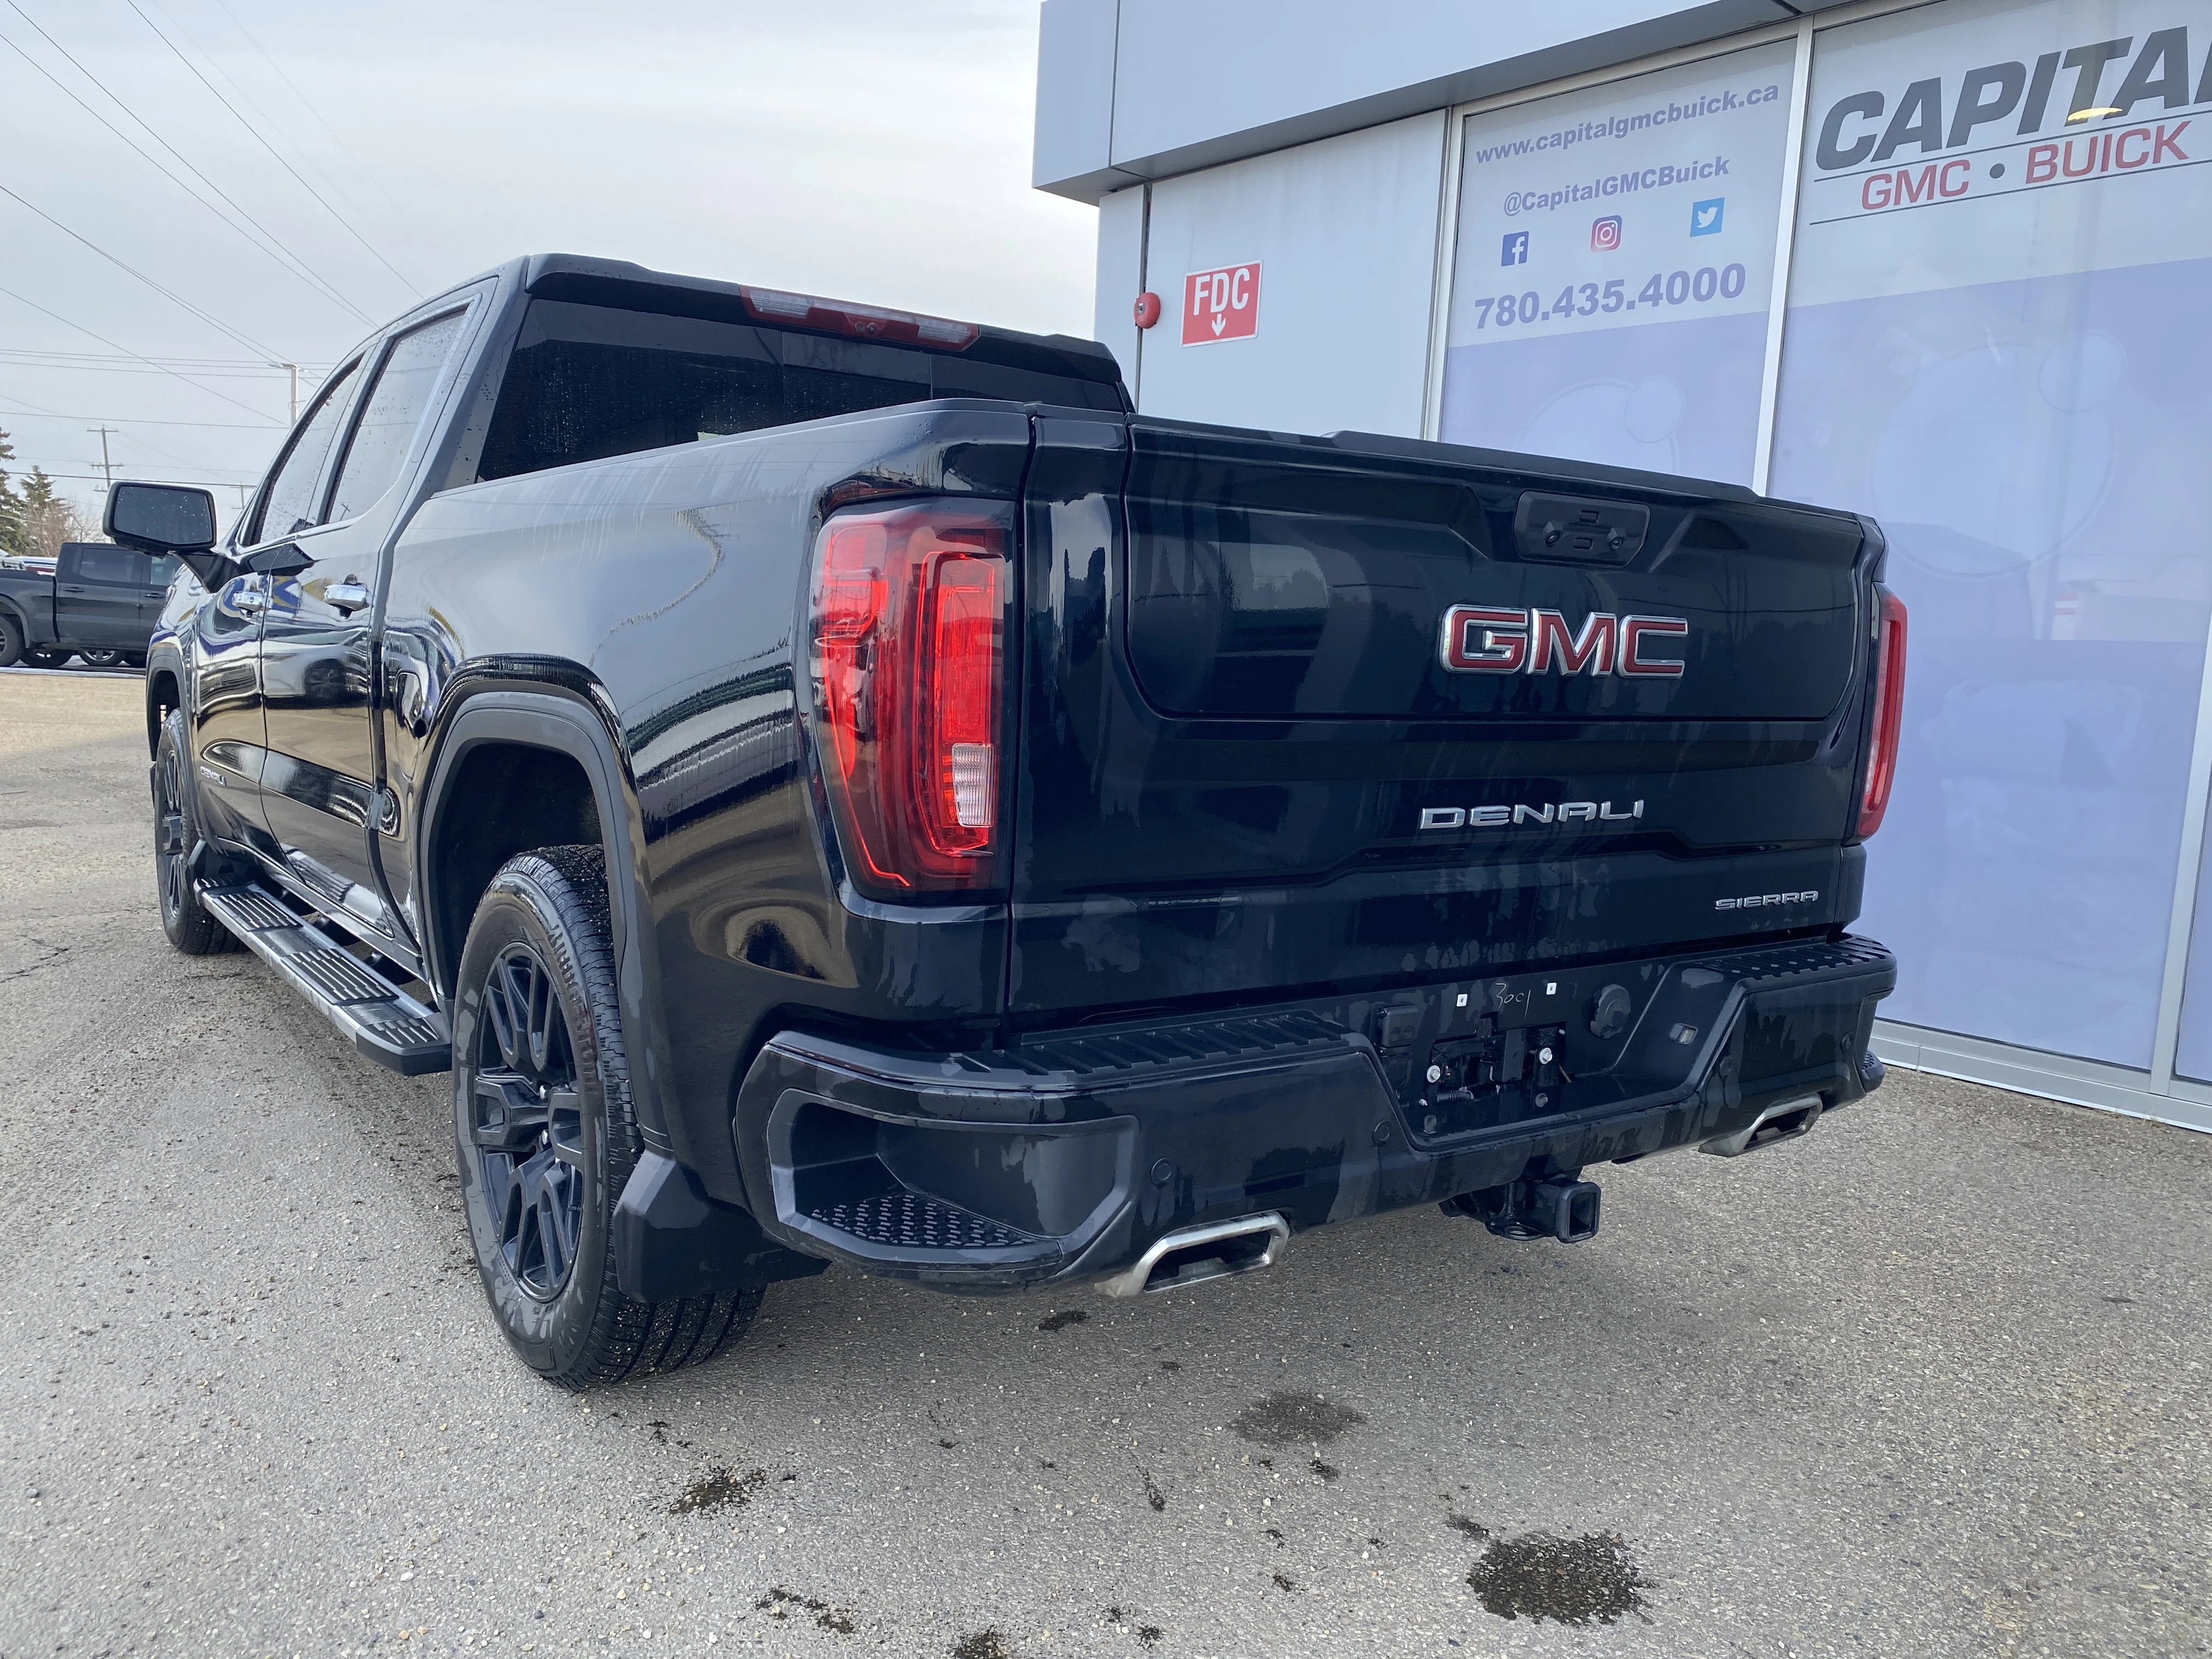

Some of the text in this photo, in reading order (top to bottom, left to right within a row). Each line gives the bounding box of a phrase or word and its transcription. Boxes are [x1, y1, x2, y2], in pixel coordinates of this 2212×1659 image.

[1476, 84, 1779, 163] www.capitalgmcbuick.ca
[1504, 156, 1731, 216] @CapitalGMCBuick
[1861, 120, 2192, 210] GMC BUICK
[1193, 268, 1250, 316] FDC
[1474, 263, 1746, 329] 780.435.4000
[1439, 603, 1689, 679] GMC
[1419, 799, 1645, 831] DENALI
[1714, 890, 1820, 911] SIERRA
